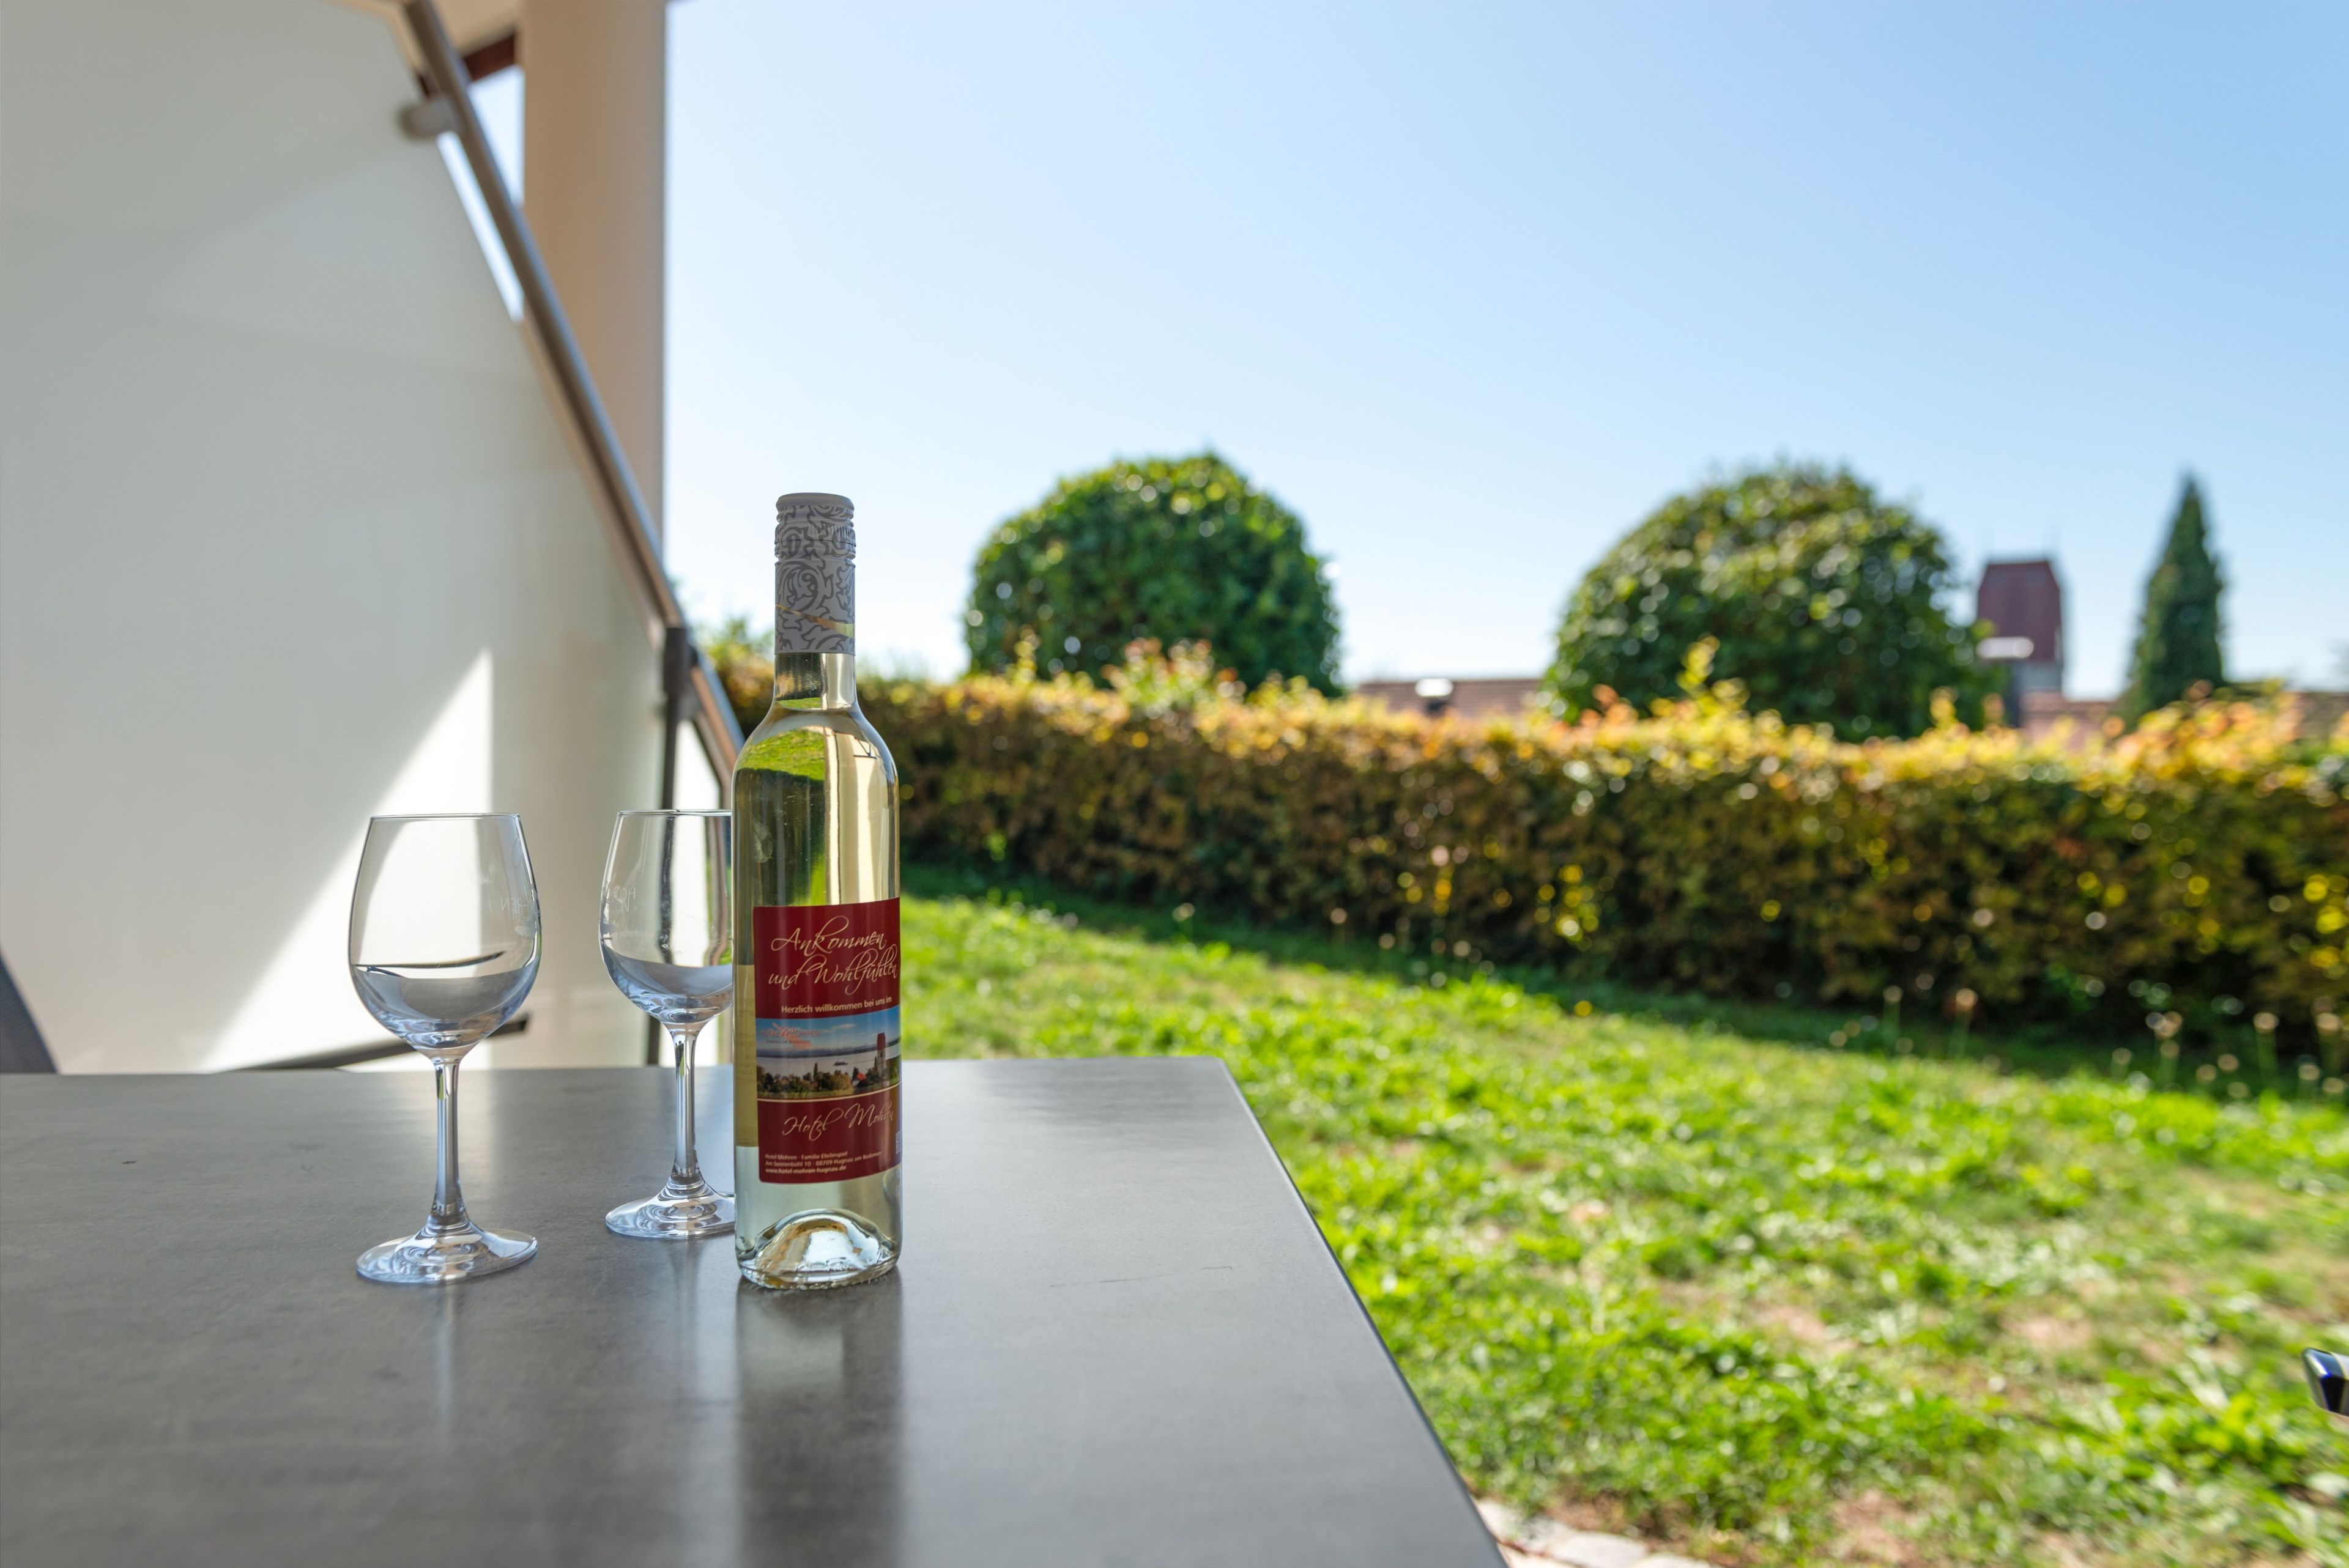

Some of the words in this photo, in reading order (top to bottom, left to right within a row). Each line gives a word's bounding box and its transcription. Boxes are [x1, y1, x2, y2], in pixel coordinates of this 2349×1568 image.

[771, 915, 887, 956] Ankommen
[768, 954, 827, 990] und
[806, 944, 897, 995] Wohlfühlen
[781, 1005, 813, 1013] Herzlich
[815, 1003, 863, 1013] willkommen
[864, 999, 874, 1008] bei
[782, 1108, 844, 1141] Hotel
